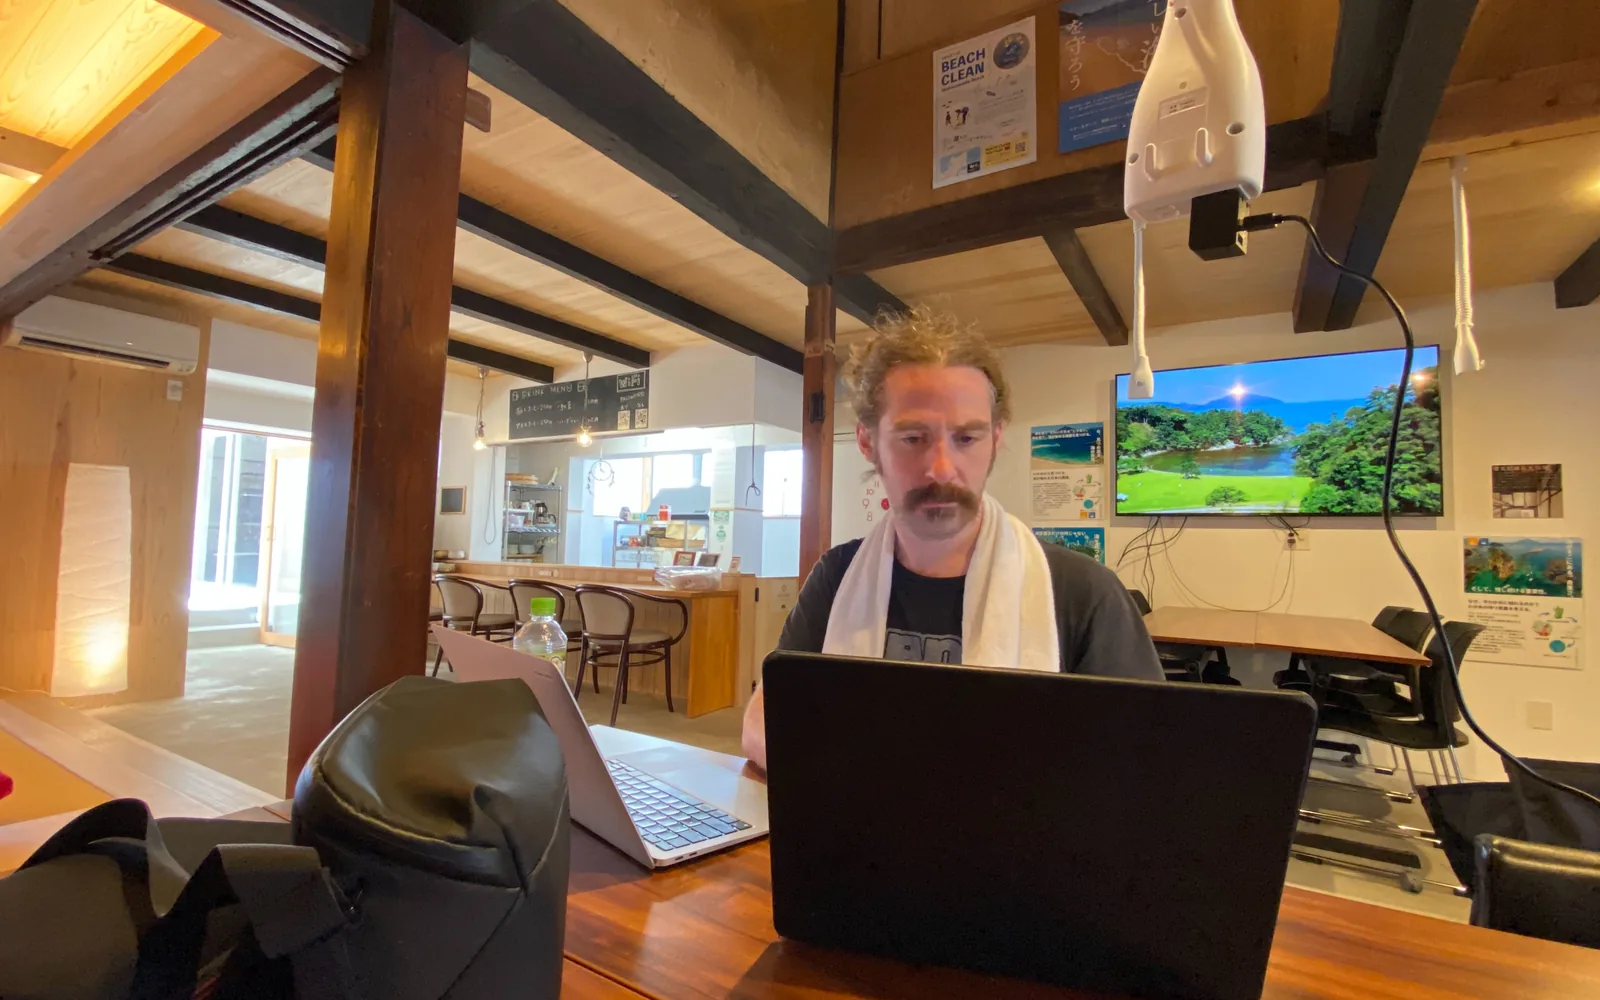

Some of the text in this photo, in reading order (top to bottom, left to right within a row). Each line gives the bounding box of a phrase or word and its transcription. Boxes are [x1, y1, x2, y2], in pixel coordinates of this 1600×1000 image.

[941, 47, 985, 73] BEACH
[1064, 19, 1086, 91] を守ろう
[941, 61, 985, 86] CLEAN
[618, 374, 641, 389] WiFi
[521, 383, 573, 400] DRINK MENU
[861, 498, 870, 509] 9
[866, 511, 873, 521] 8
